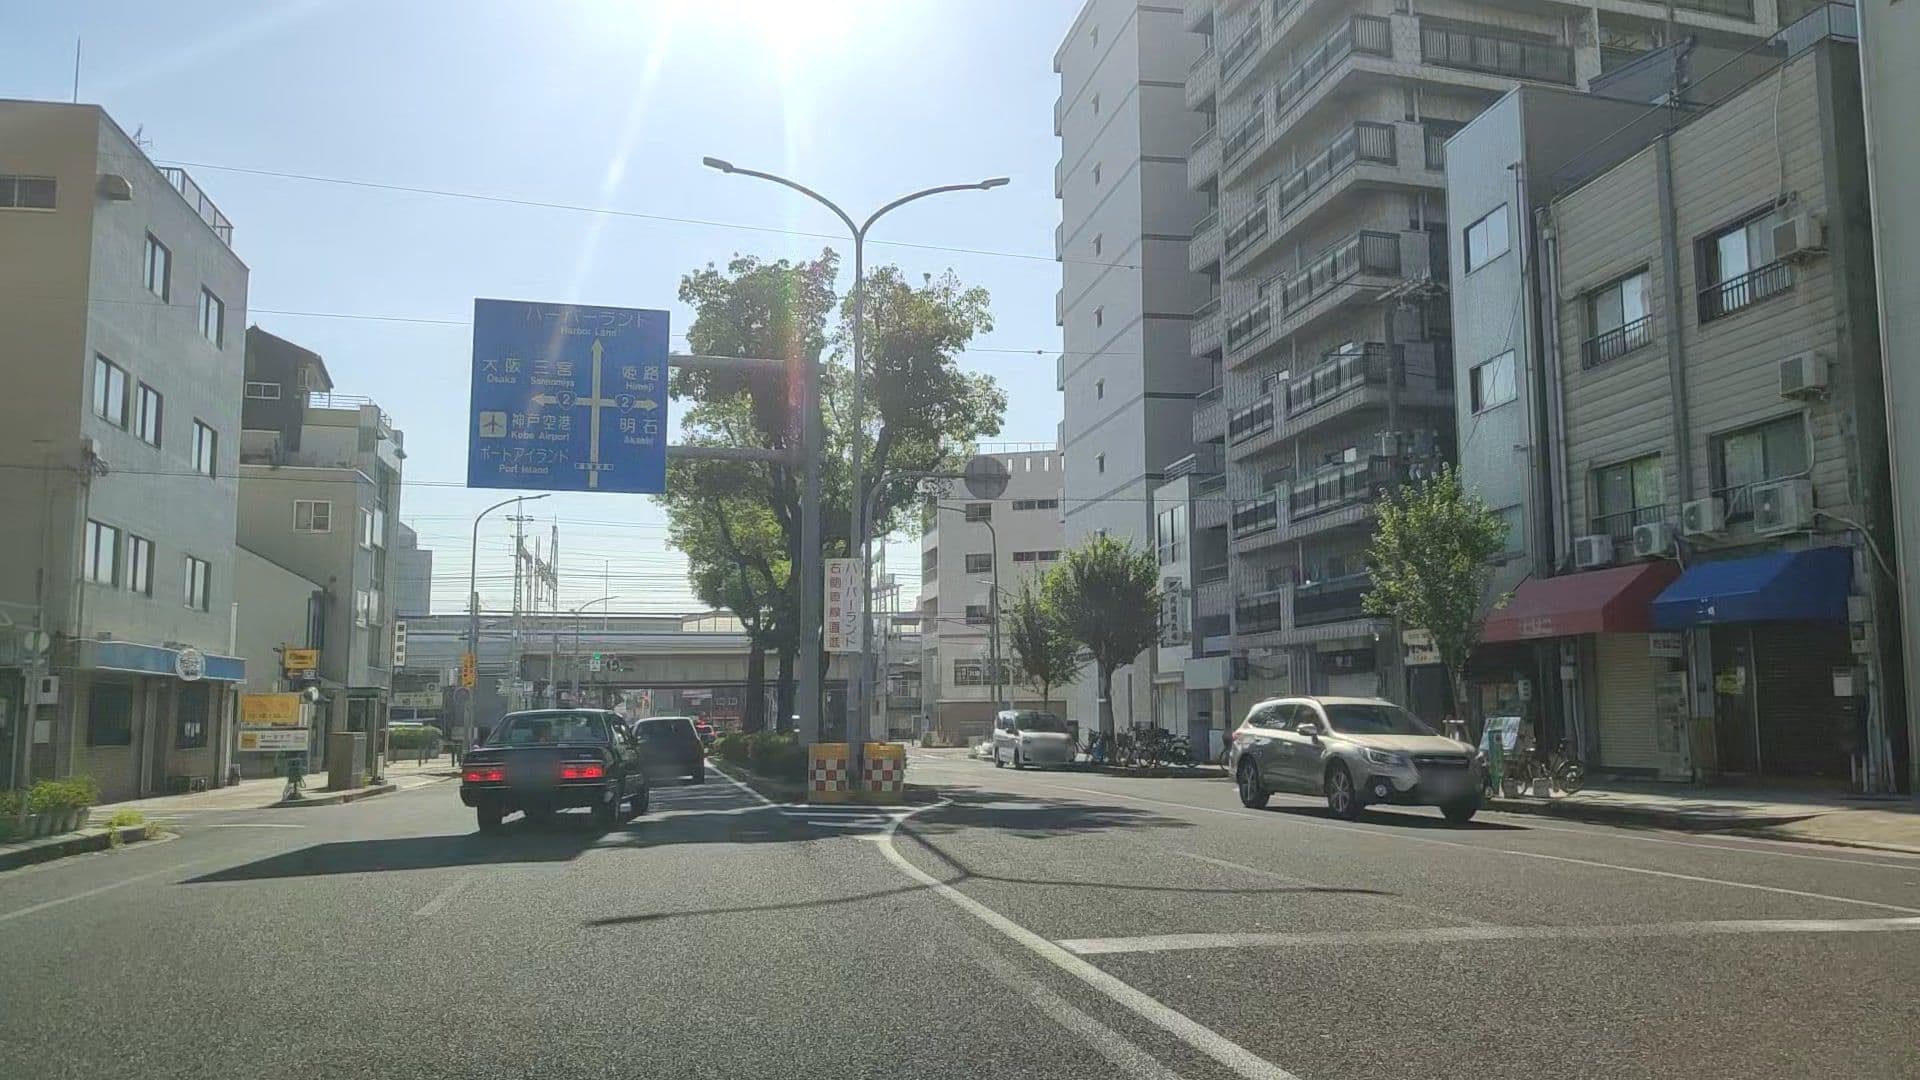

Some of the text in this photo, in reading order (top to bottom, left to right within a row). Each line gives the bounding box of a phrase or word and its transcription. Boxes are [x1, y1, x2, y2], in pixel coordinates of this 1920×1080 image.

[560, 327, 592, 336] Harbor
[481, 358, 575, 376] 大阪 三宮
[622, 365, 659, 381] 姫路
[486, 373, 575, 389] Osaka Sannomiya
[625, 381, 655, 392] Himeji
[562, 393, 571, 405] 2
[622, 396, 630, 408] 2
[511, 412, 571, 430] 神戸空港
[620, 417, 657, 434] 明石
[511, 431, 570, 442] Kobe Airport
[480, 445, 569, 464] ポートアイランド
[498, 464, 549, 474] Port Island
